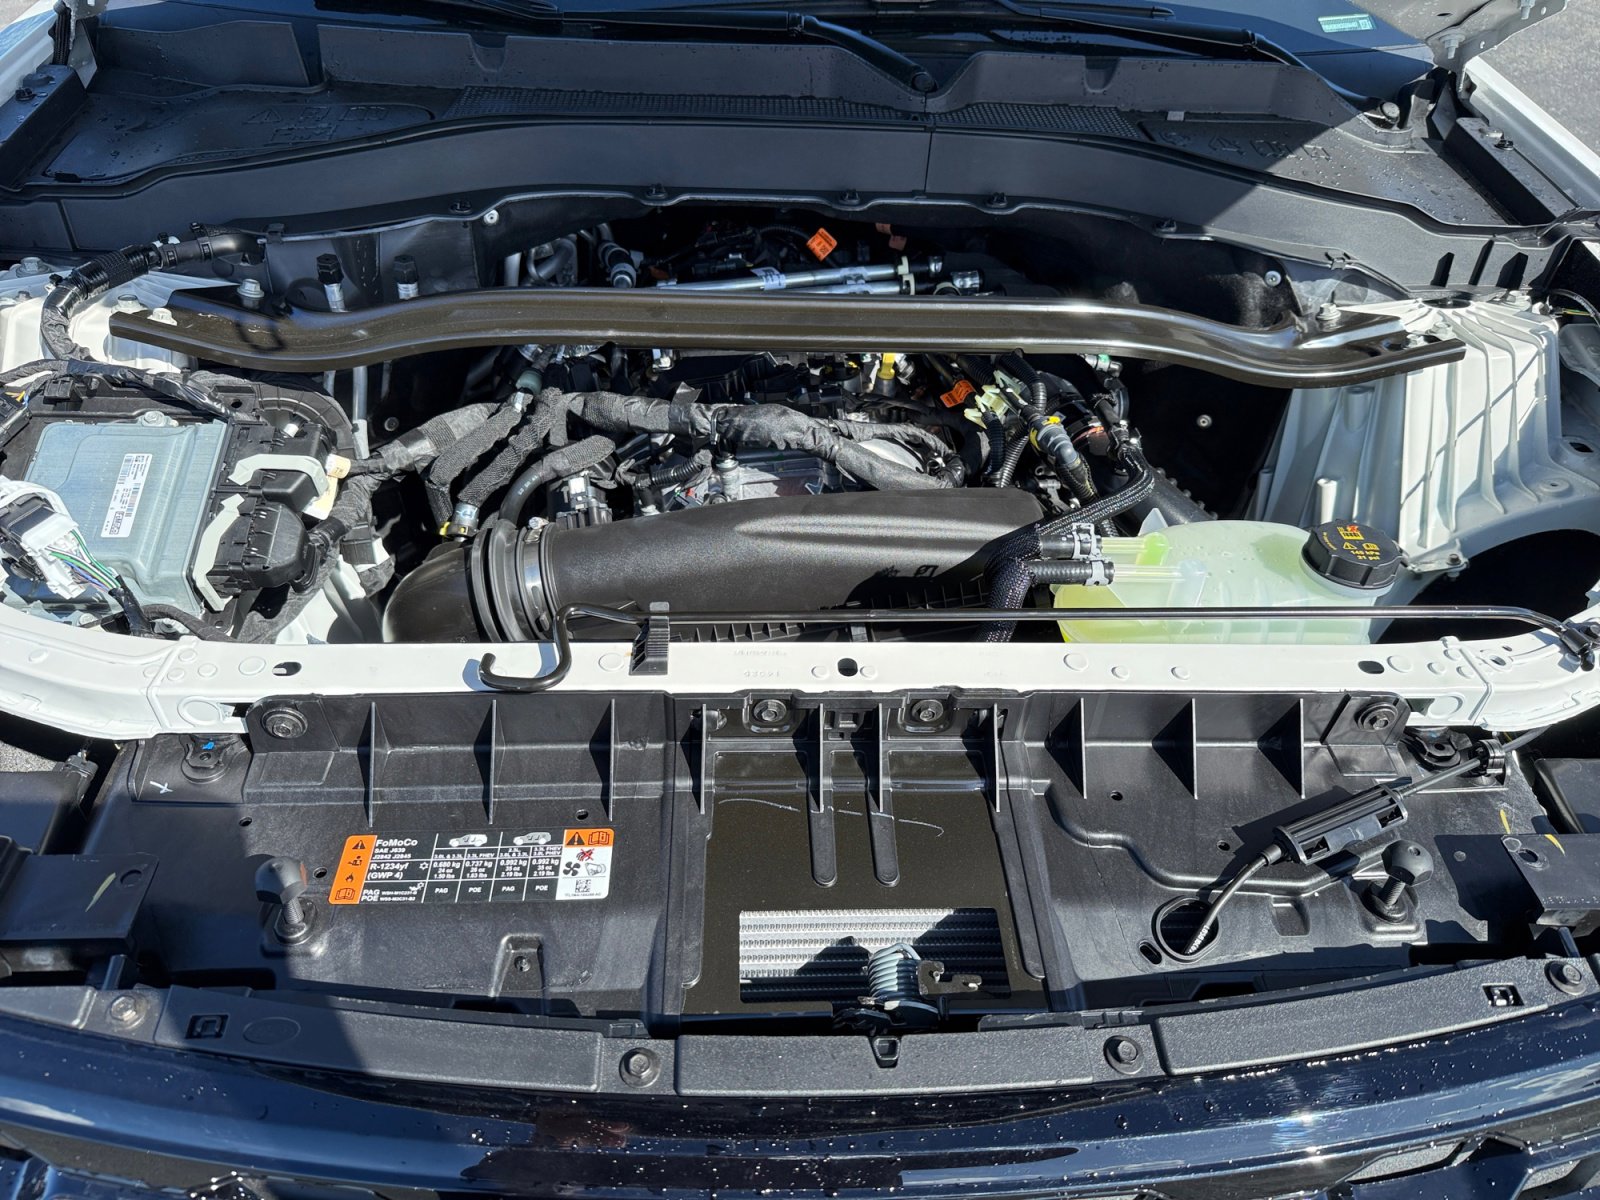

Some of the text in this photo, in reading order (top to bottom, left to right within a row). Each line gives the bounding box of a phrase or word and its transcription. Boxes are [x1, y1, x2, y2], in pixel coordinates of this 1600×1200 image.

[375, 839, 418, 847] FoMoCo
[550, 858, 559, 866] kg
[370, 862, 409, 871] R-1234yf
[367, 872, 403, 880] (GWP 4)
